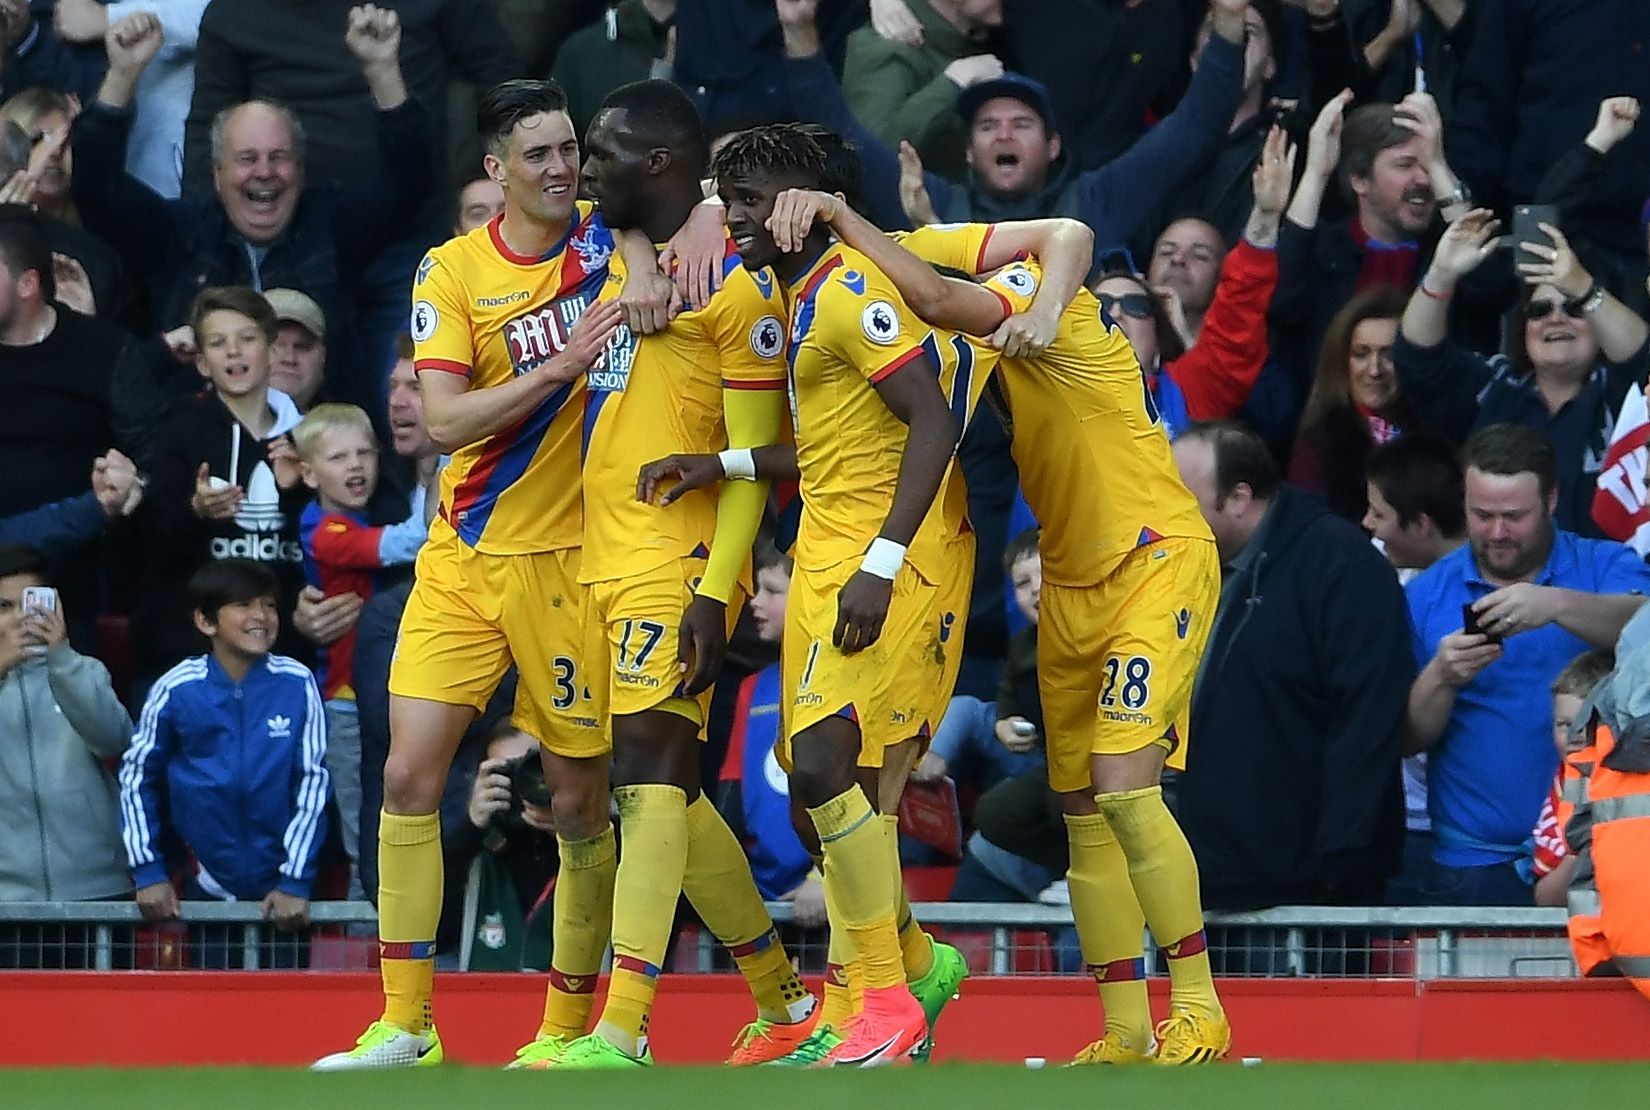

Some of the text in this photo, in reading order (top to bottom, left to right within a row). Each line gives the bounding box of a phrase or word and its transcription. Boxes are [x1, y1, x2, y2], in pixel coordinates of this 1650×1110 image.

[477, 291, 530, 308] macron
[616, 619, 665, 672] 17
[551, 655, 593, 709] 3
[1098, 655, 1152, 710] 28
